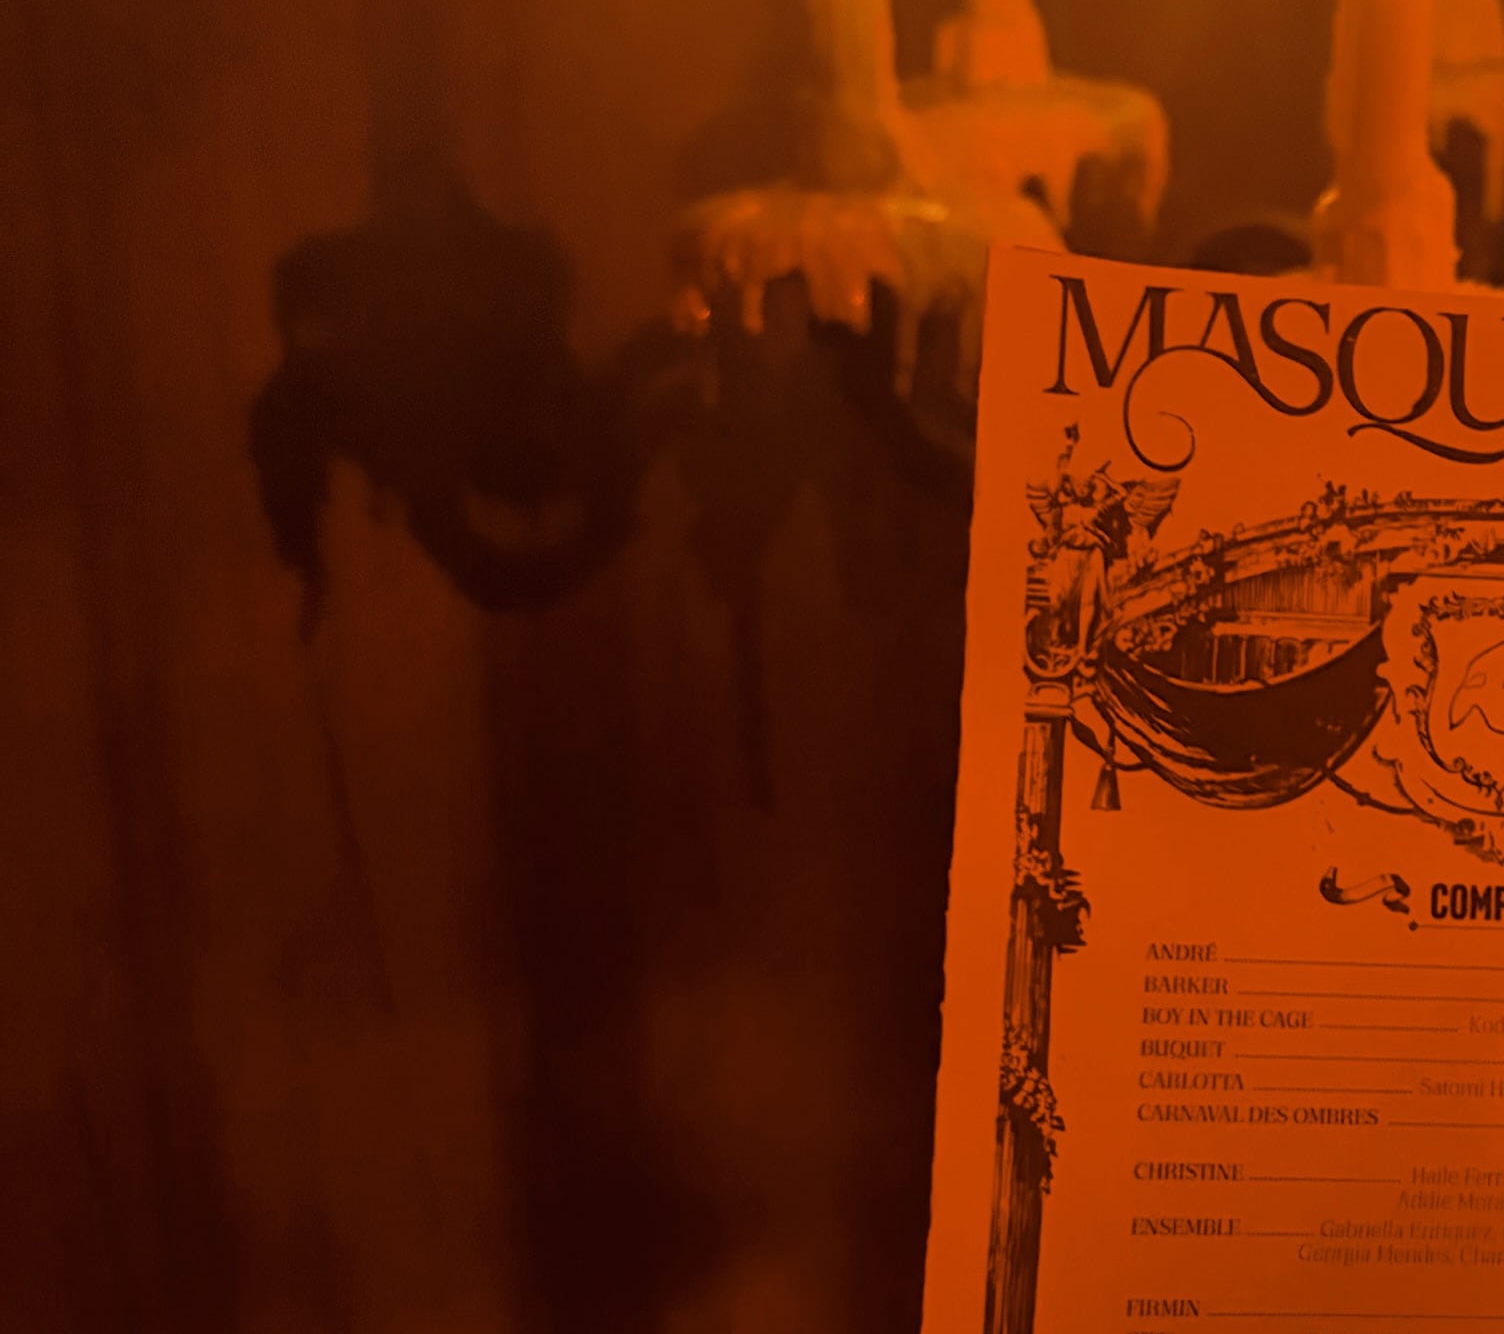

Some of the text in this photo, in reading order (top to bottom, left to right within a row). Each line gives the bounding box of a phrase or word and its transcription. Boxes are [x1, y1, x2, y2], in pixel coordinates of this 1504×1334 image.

[1146, 942, 1217, 962] ANDRÉ
[1144, 976, 1228, 995] BARKER
[1142, 1007, 1183, 1025] BOY
[1188, 1008, 1209, 1026] IN
[1215, 1009, 1255, 1027] THE
[1259, 1011, 1313, 1029] CAGE
[1140, 1039, 1226, 1060] BUQUET
[1139, 1071, 1244, 1091] CARLOTTA
[1421, 1077, 1484, 1097] Satomi
[1137, 1104, 1245, 1123] CARNAVAL
[1249, 1106, 1288, 1124] DES
[1293, 1107, 1379, 1125] OMBRES
[1134, 1162, 1244, 1181] CHRISTINE
[1131, 1218, 1240, 1236] ENSEMBLE
[1320, 1219, 1404, 1239] Gabriella
[1126, 1299, 1200, 1318] FIRMIN
